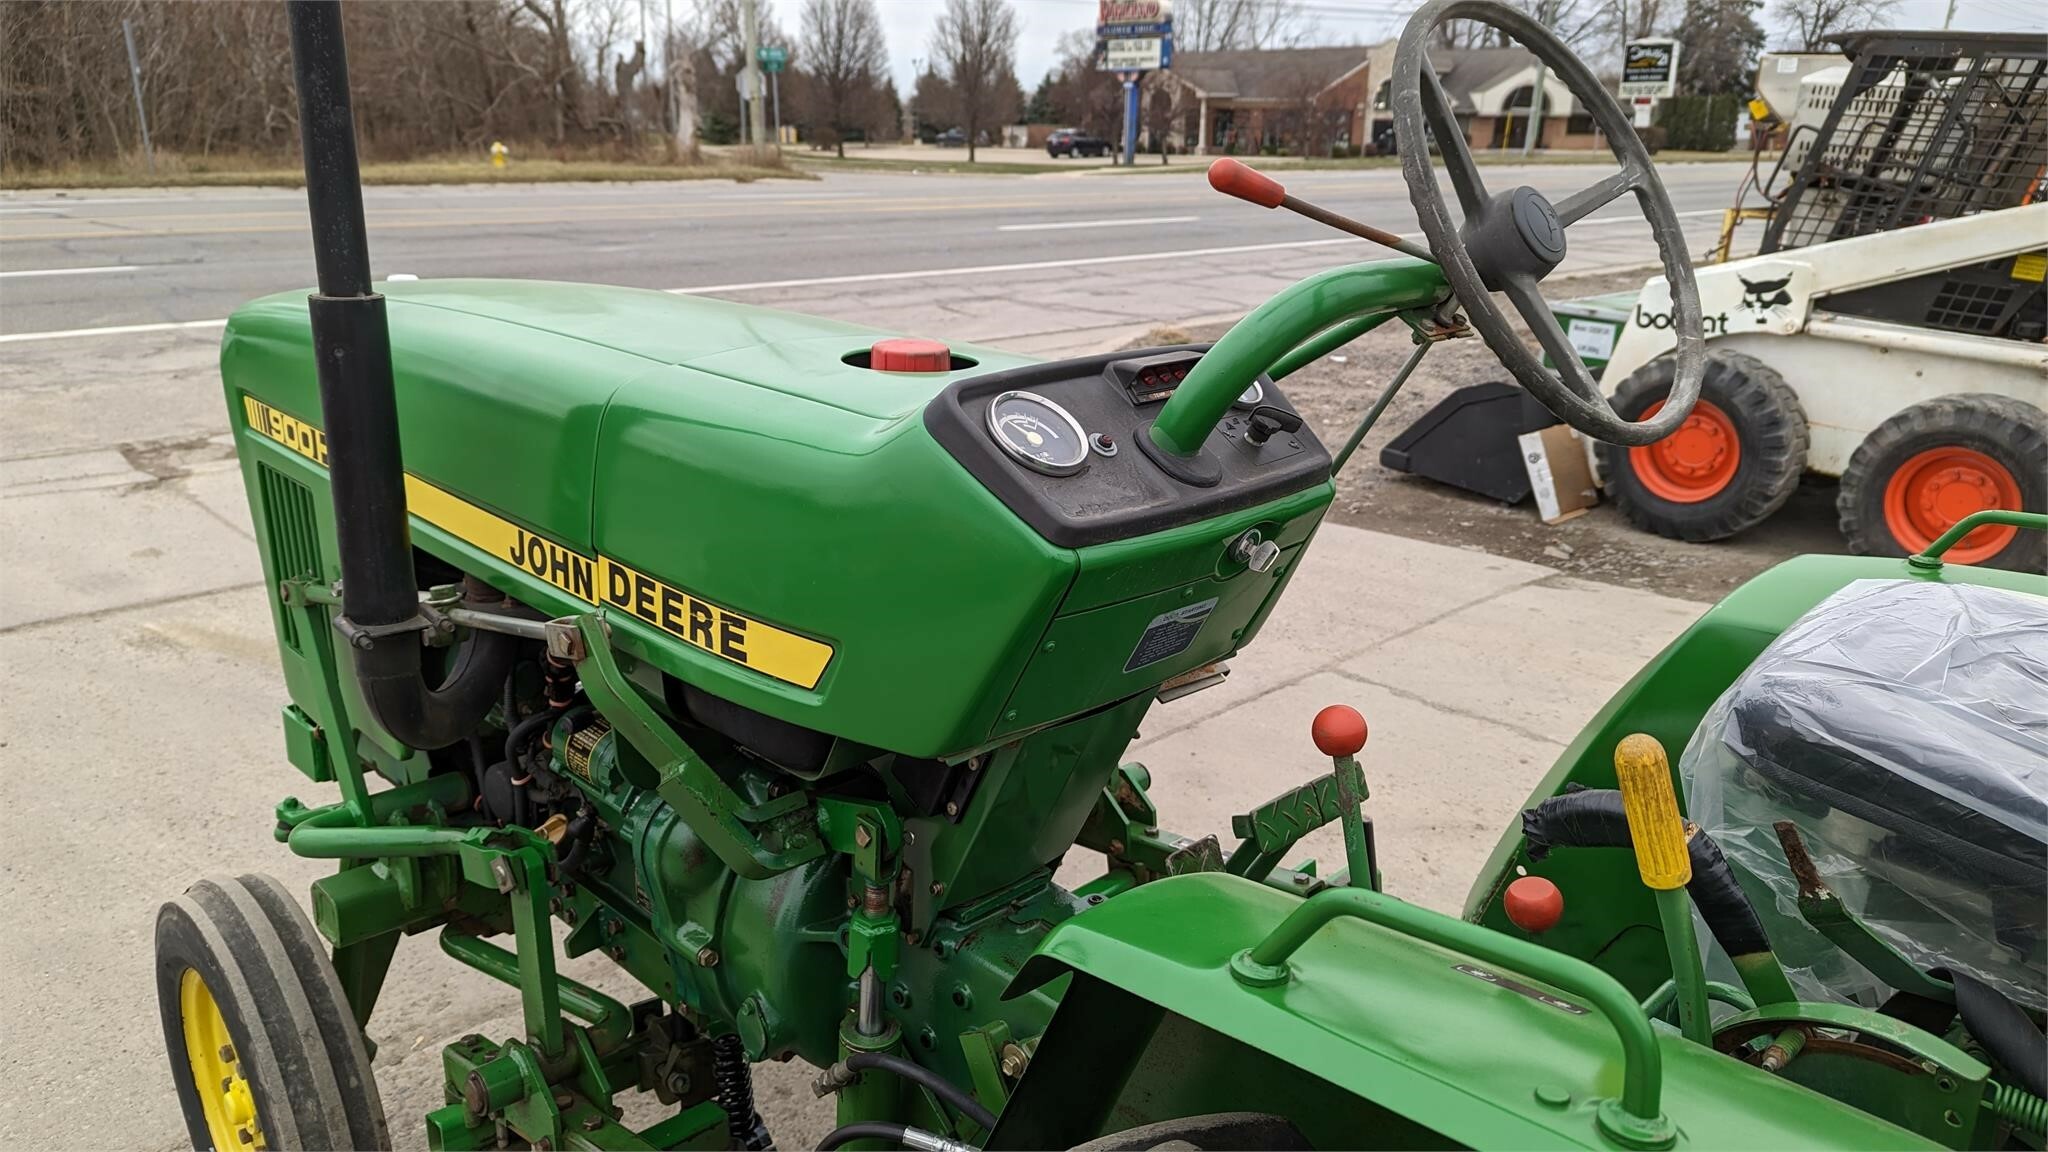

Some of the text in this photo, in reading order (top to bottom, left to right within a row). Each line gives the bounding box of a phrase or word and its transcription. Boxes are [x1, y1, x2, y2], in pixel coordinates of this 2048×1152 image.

[1636, 304, 1729, 335] boat
[510, 529, 748, 664] JOHN DEERE
